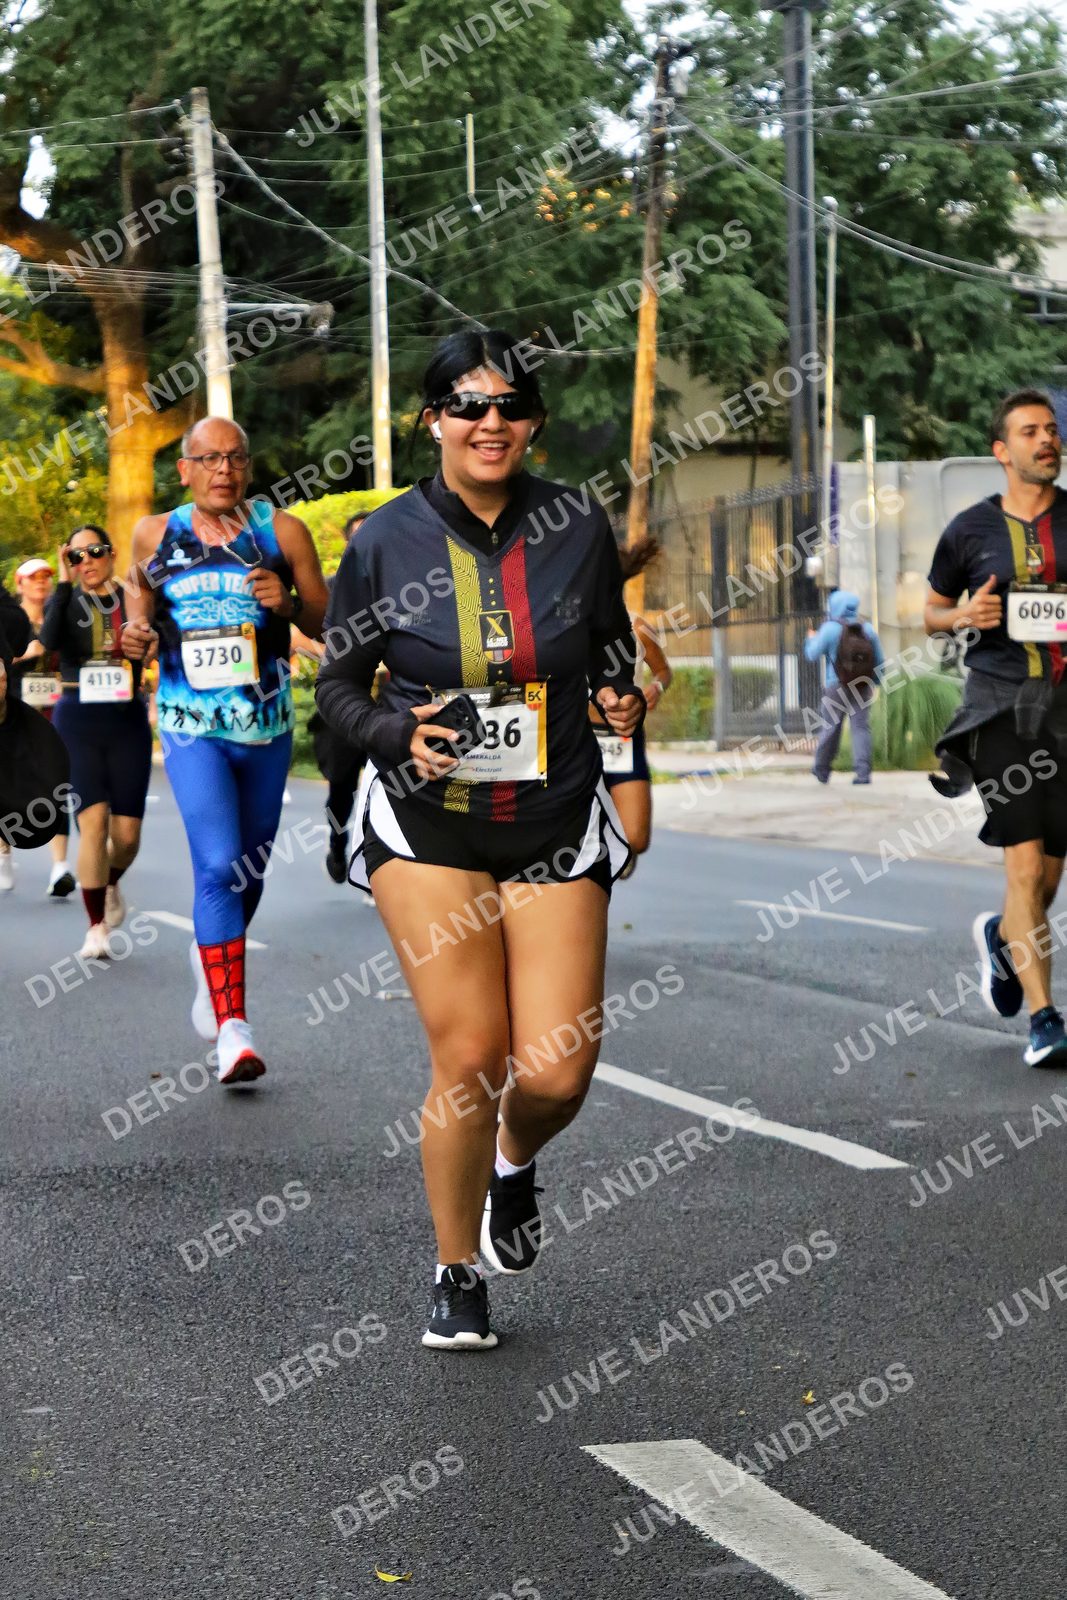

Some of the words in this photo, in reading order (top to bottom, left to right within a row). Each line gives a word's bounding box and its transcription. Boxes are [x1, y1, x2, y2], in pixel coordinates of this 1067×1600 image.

[170, 572, 219, 598] SUPER
[1018, 601, 1065, 620] 6096
[193, 645, 242, 668] 3730
[88, 672, 122, 686] 4119
[527, 692, 542, 703] 5K
[484, 716, 521, 749] 36
